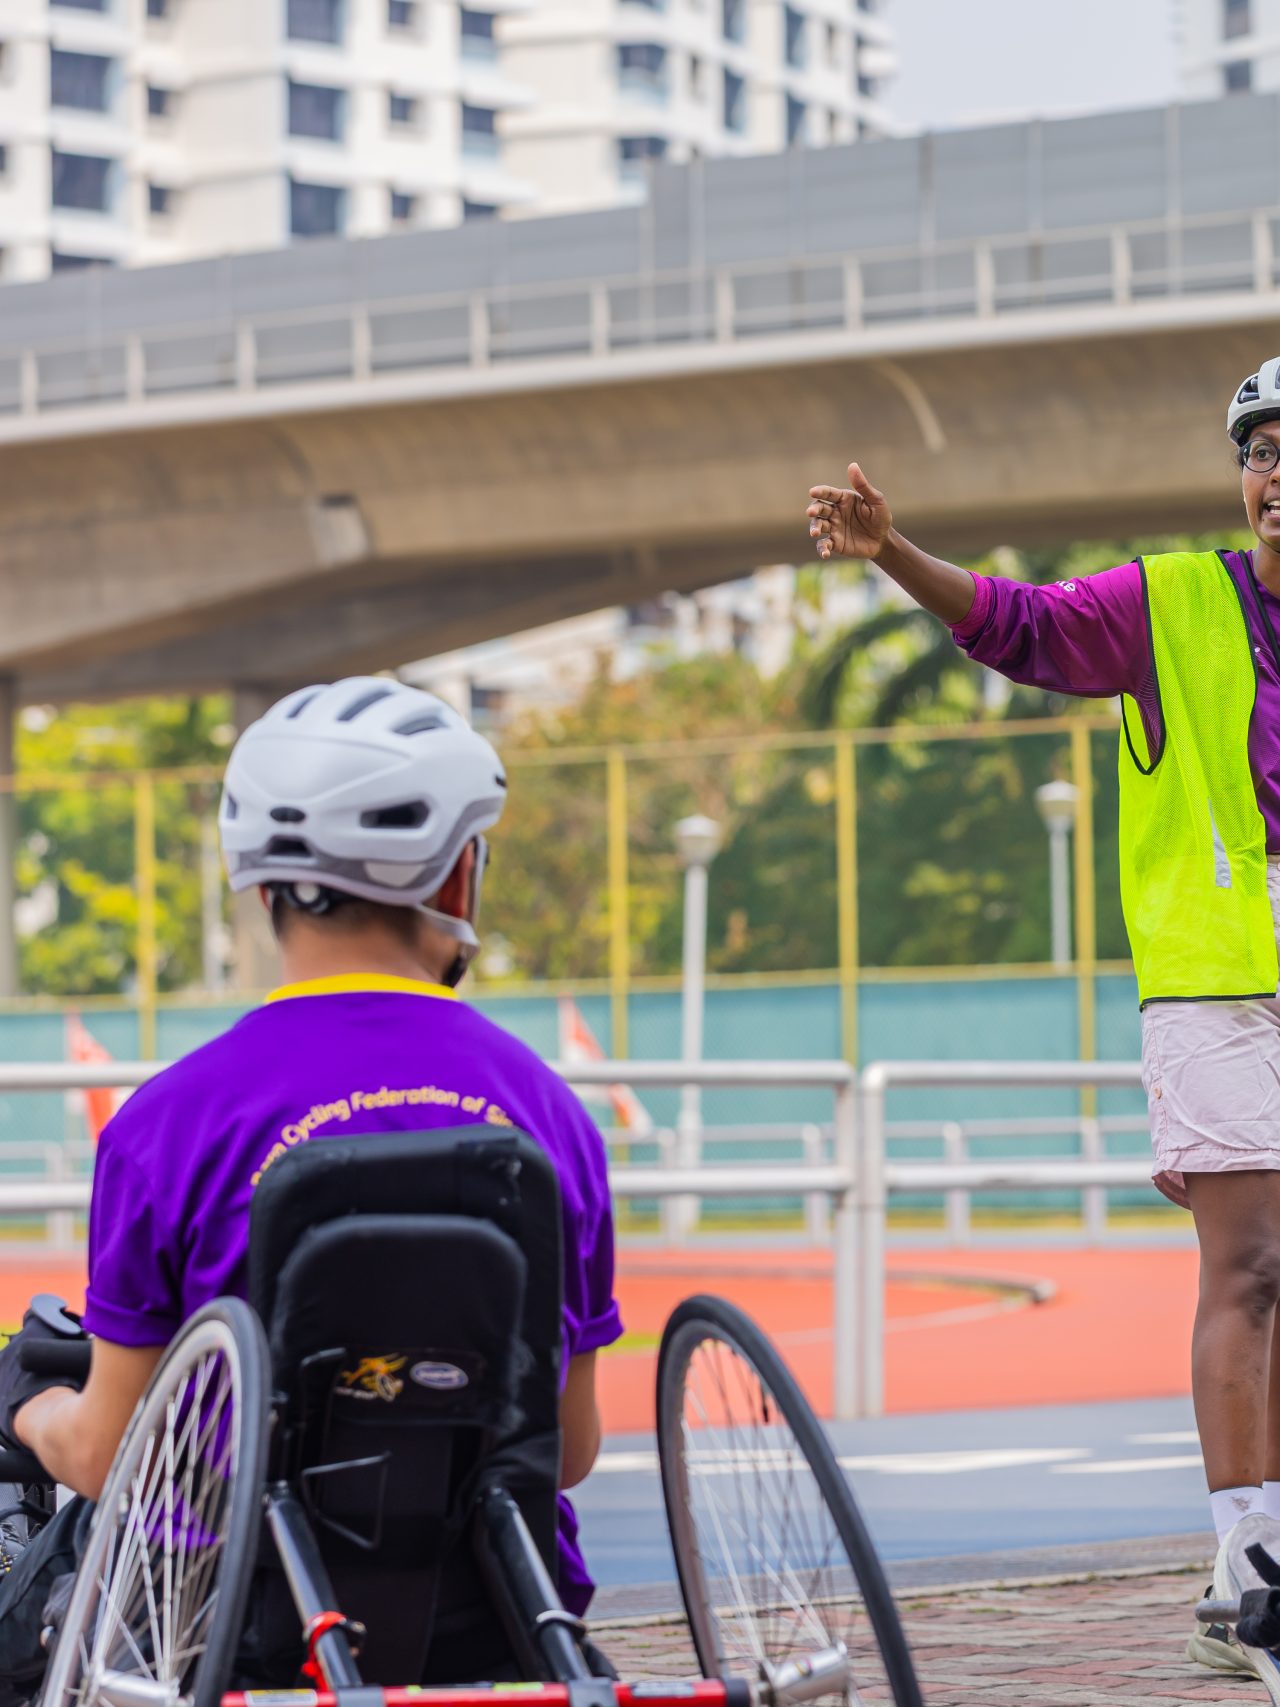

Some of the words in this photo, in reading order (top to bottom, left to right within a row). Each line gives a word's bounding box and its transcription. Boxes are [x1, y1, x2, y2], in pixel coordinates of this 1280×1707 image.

[281, 1099, 351, 1146] Cycling
[351, 1086, 459, 1112] Federation
[461, 1096, 487, 1114] of
